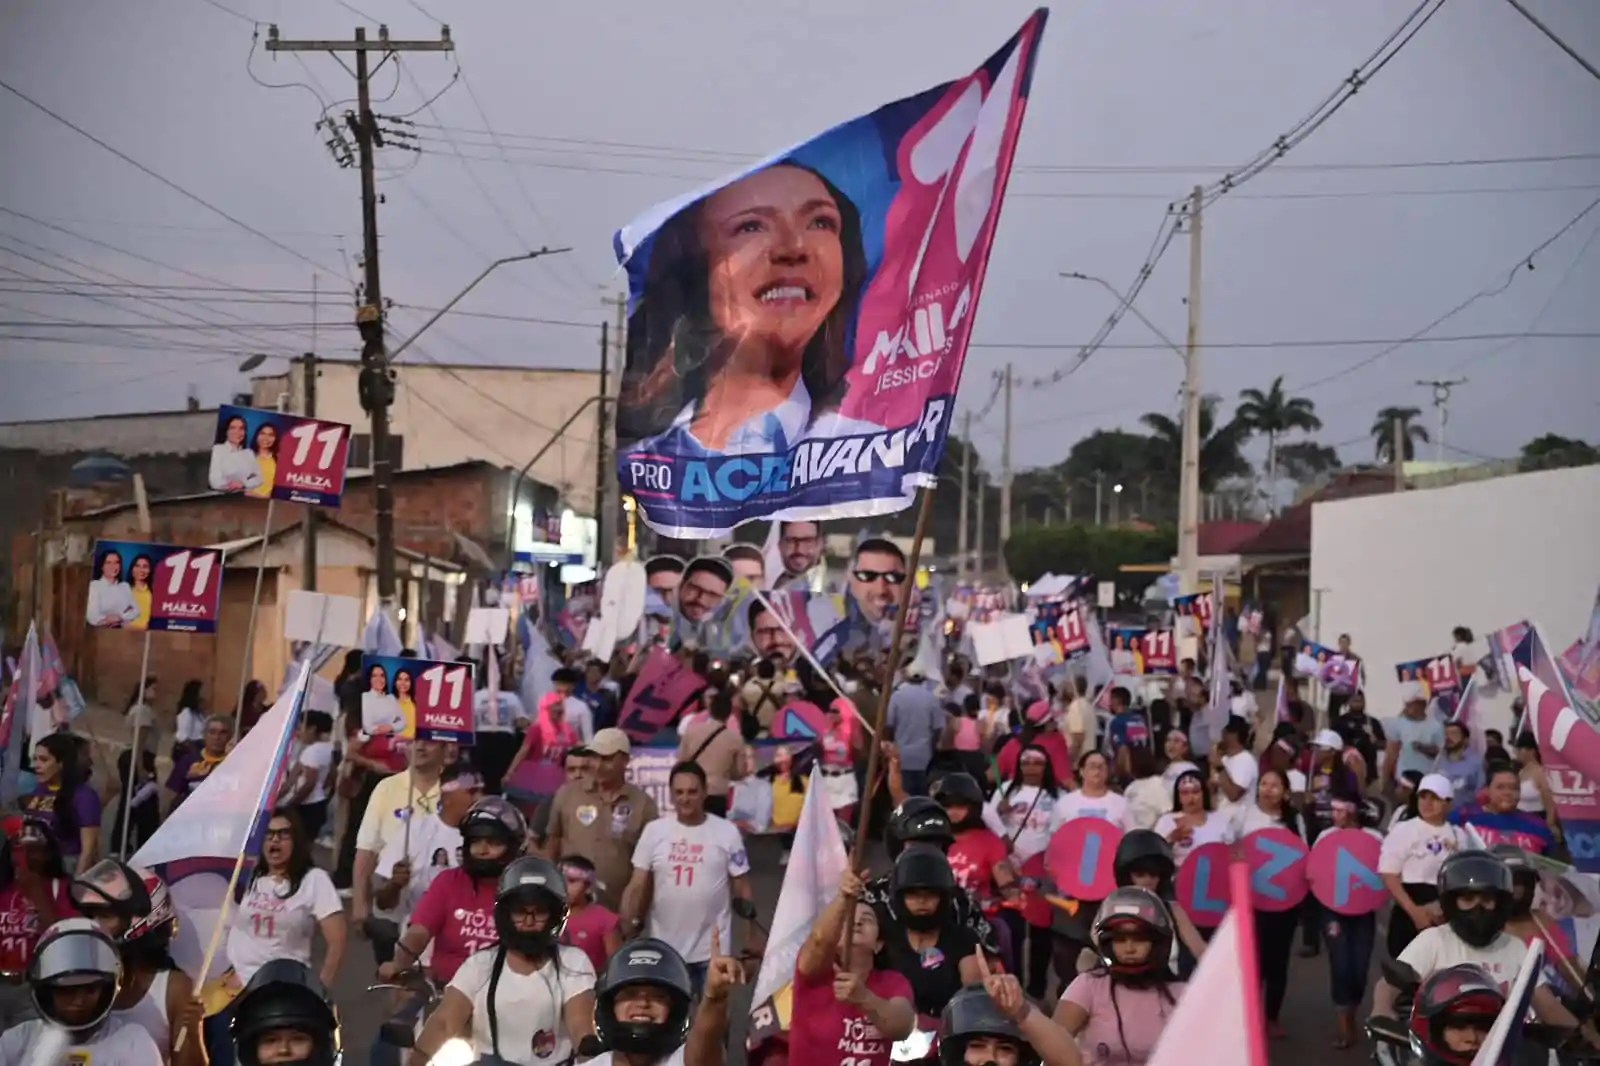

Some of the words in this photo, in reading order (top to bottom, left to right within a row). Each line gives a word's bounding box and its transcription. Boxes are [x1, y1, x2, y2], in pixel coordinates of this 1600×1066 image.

[291, 422, 345, 470] 11
[286, 472, 332, 489] MAILZA
[631, 462, 672, 491] PRO
[165, 550, 216, 597] 11
[162, 602, 207, 615] MAILZA
[1056, 610, 1081, 641] 11
[1143, 631, 1171, 657] 11
[1427, 656, 1451, 681] 11
[423, 664, 467, 710] 11
[673, 865, 693, 887] 11
[1193, 854, 1230, 912] L
[1334, 847, 1386, 907] A
[250, 912, 275, 939] 11
[460, 926, 500, 940] MAILZ
[837, 1038, 885, 1055] MAILZA
